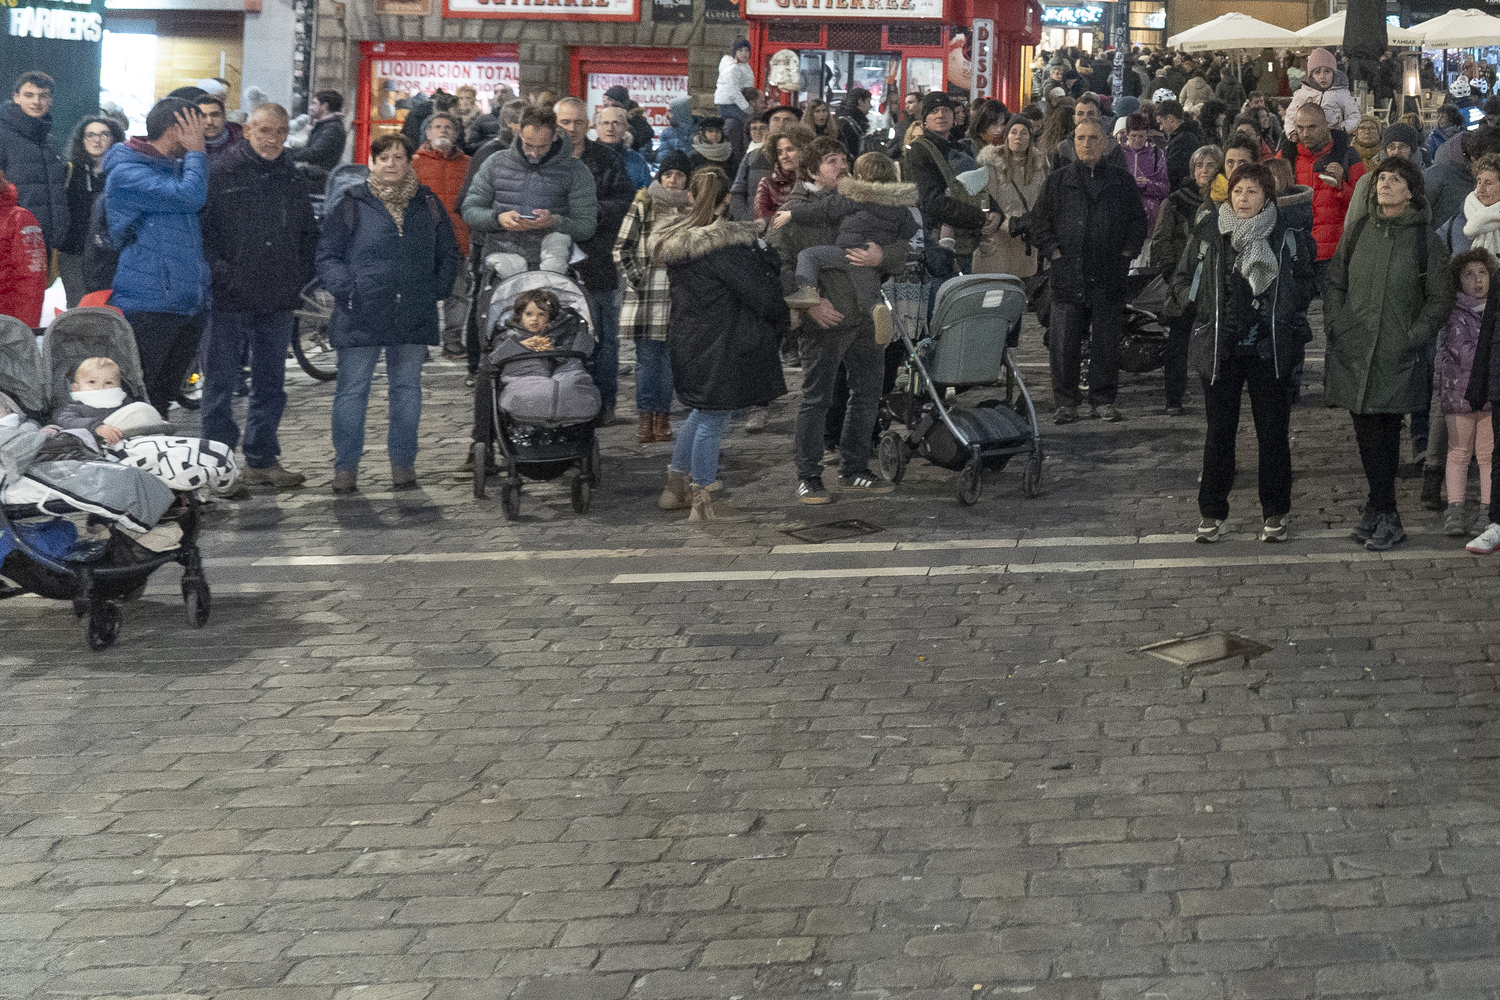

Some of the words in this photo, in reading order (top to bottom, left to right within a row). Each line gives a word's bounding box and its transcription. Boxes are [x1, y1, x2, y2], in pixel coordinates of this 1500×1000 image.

[10, 6, 103, 43] FARMERS
[381, 61, 471, 79] LIQUIDACION
[477, 64, 519, 80] TOTAL
